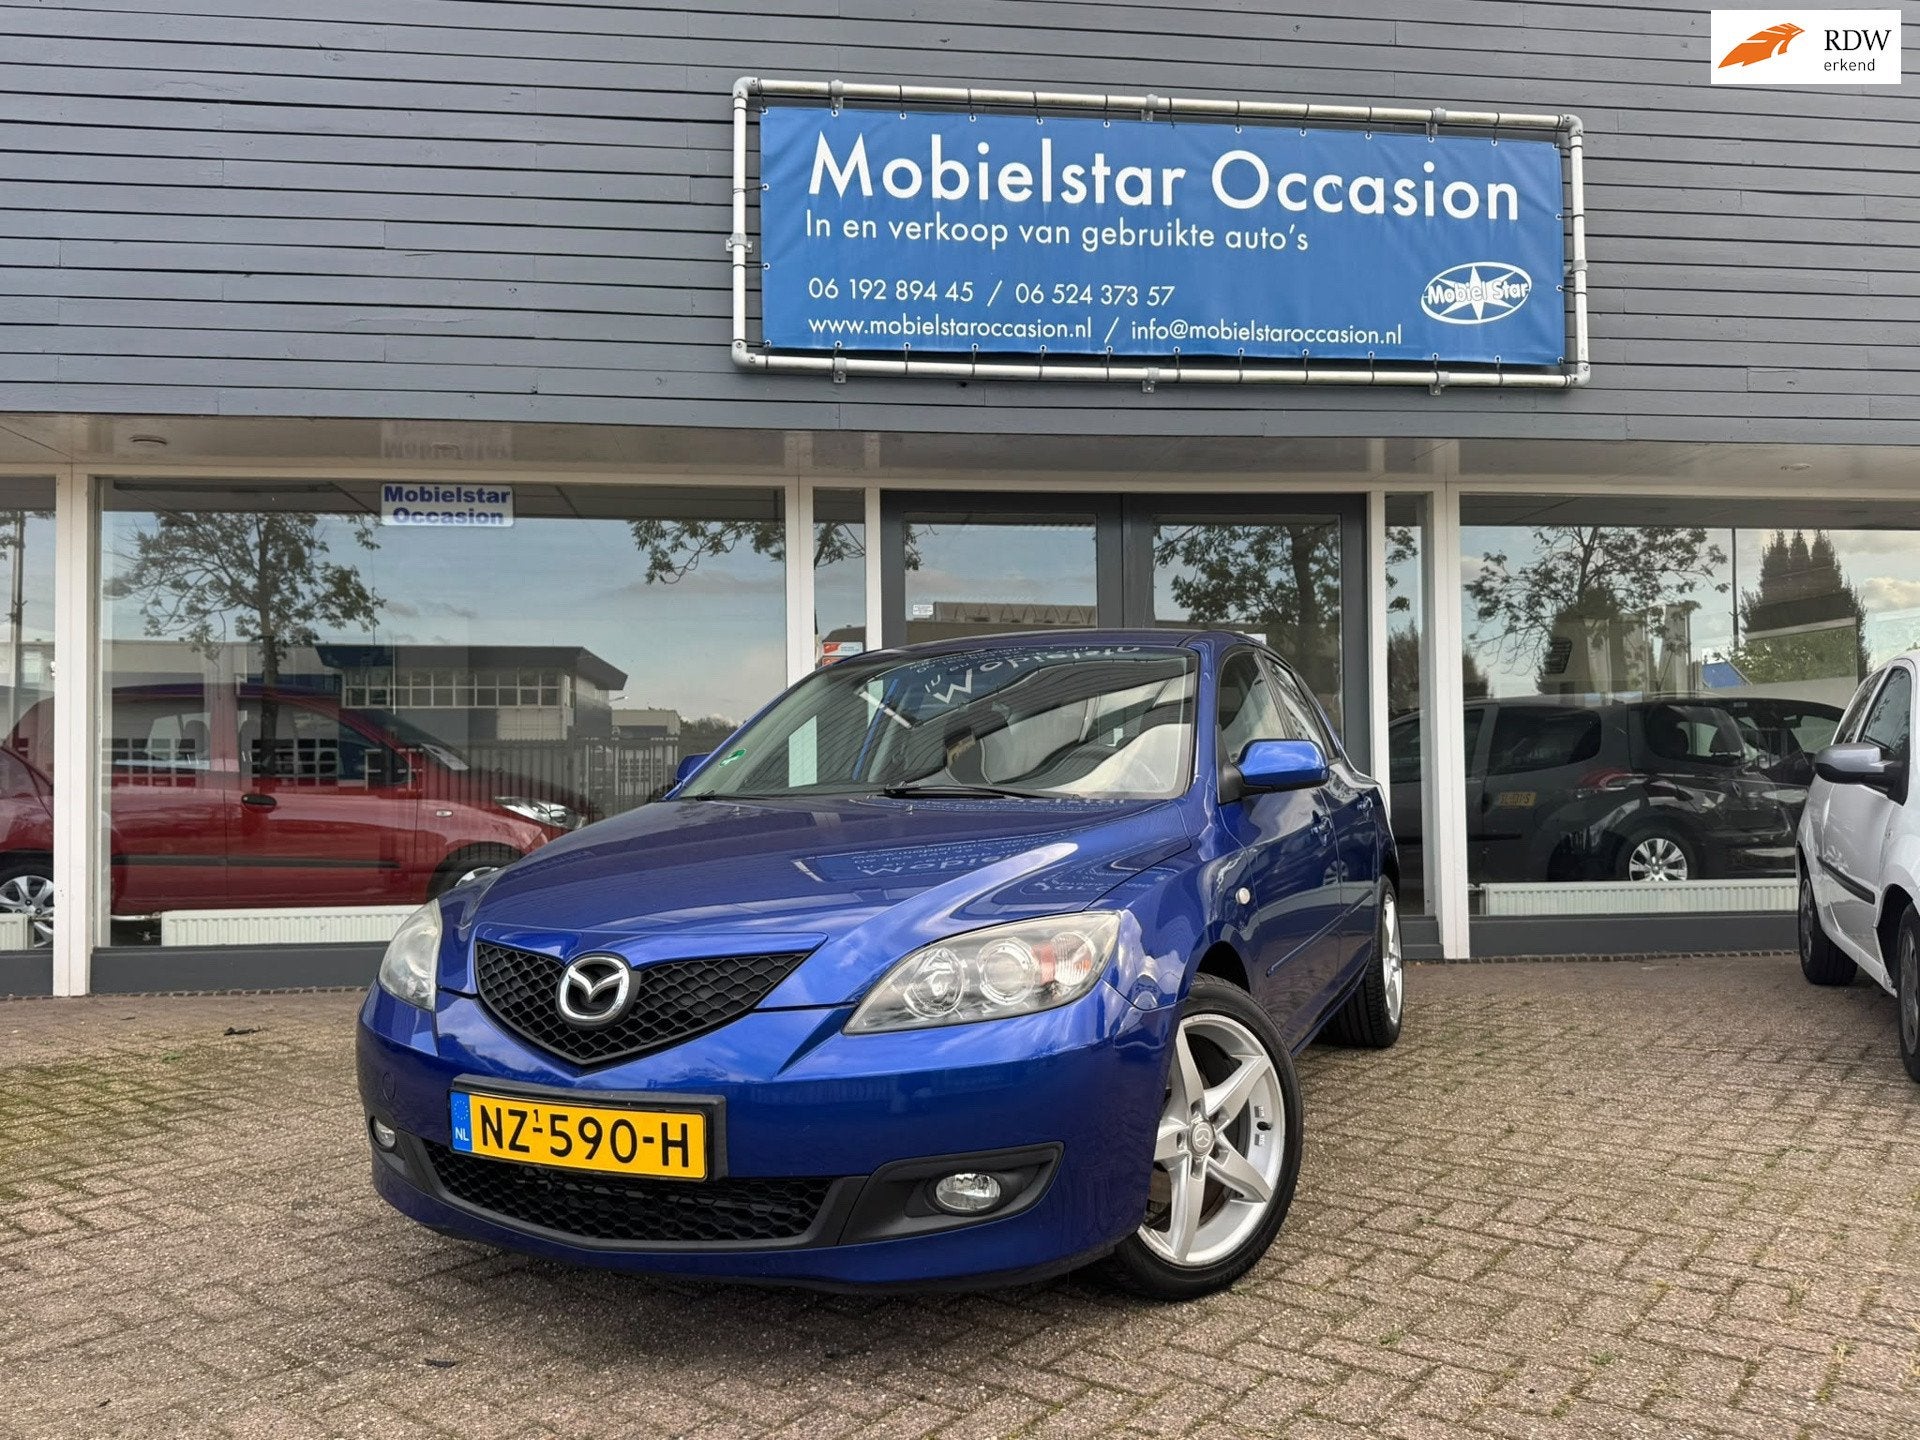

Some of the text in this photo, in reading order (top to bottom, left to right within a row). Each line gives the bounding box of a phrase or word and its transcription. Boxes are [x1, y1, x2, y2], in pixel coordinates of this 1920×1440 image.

[808, 130, 1519, 222] Mobielstar Occasion
[806, 208, 1309, 253] In en verkoop van gebruikte auto's
[808, 277, 1176, 308] 06 192 894 45 / 06 524 373 57
[1427, 280, 1528, 305] Mobiel Star
[807, 312, 1402, 345] www.mobielstaroccasion.nl / info@mobielstaroccasion.nl
[384, 486, 510, 503] Mobielstar
[393, 507, 504, 524] Occasion
[455, 1128, 469, 1142] NL
[480, 1104, 690, 1168] NZ-590-H
